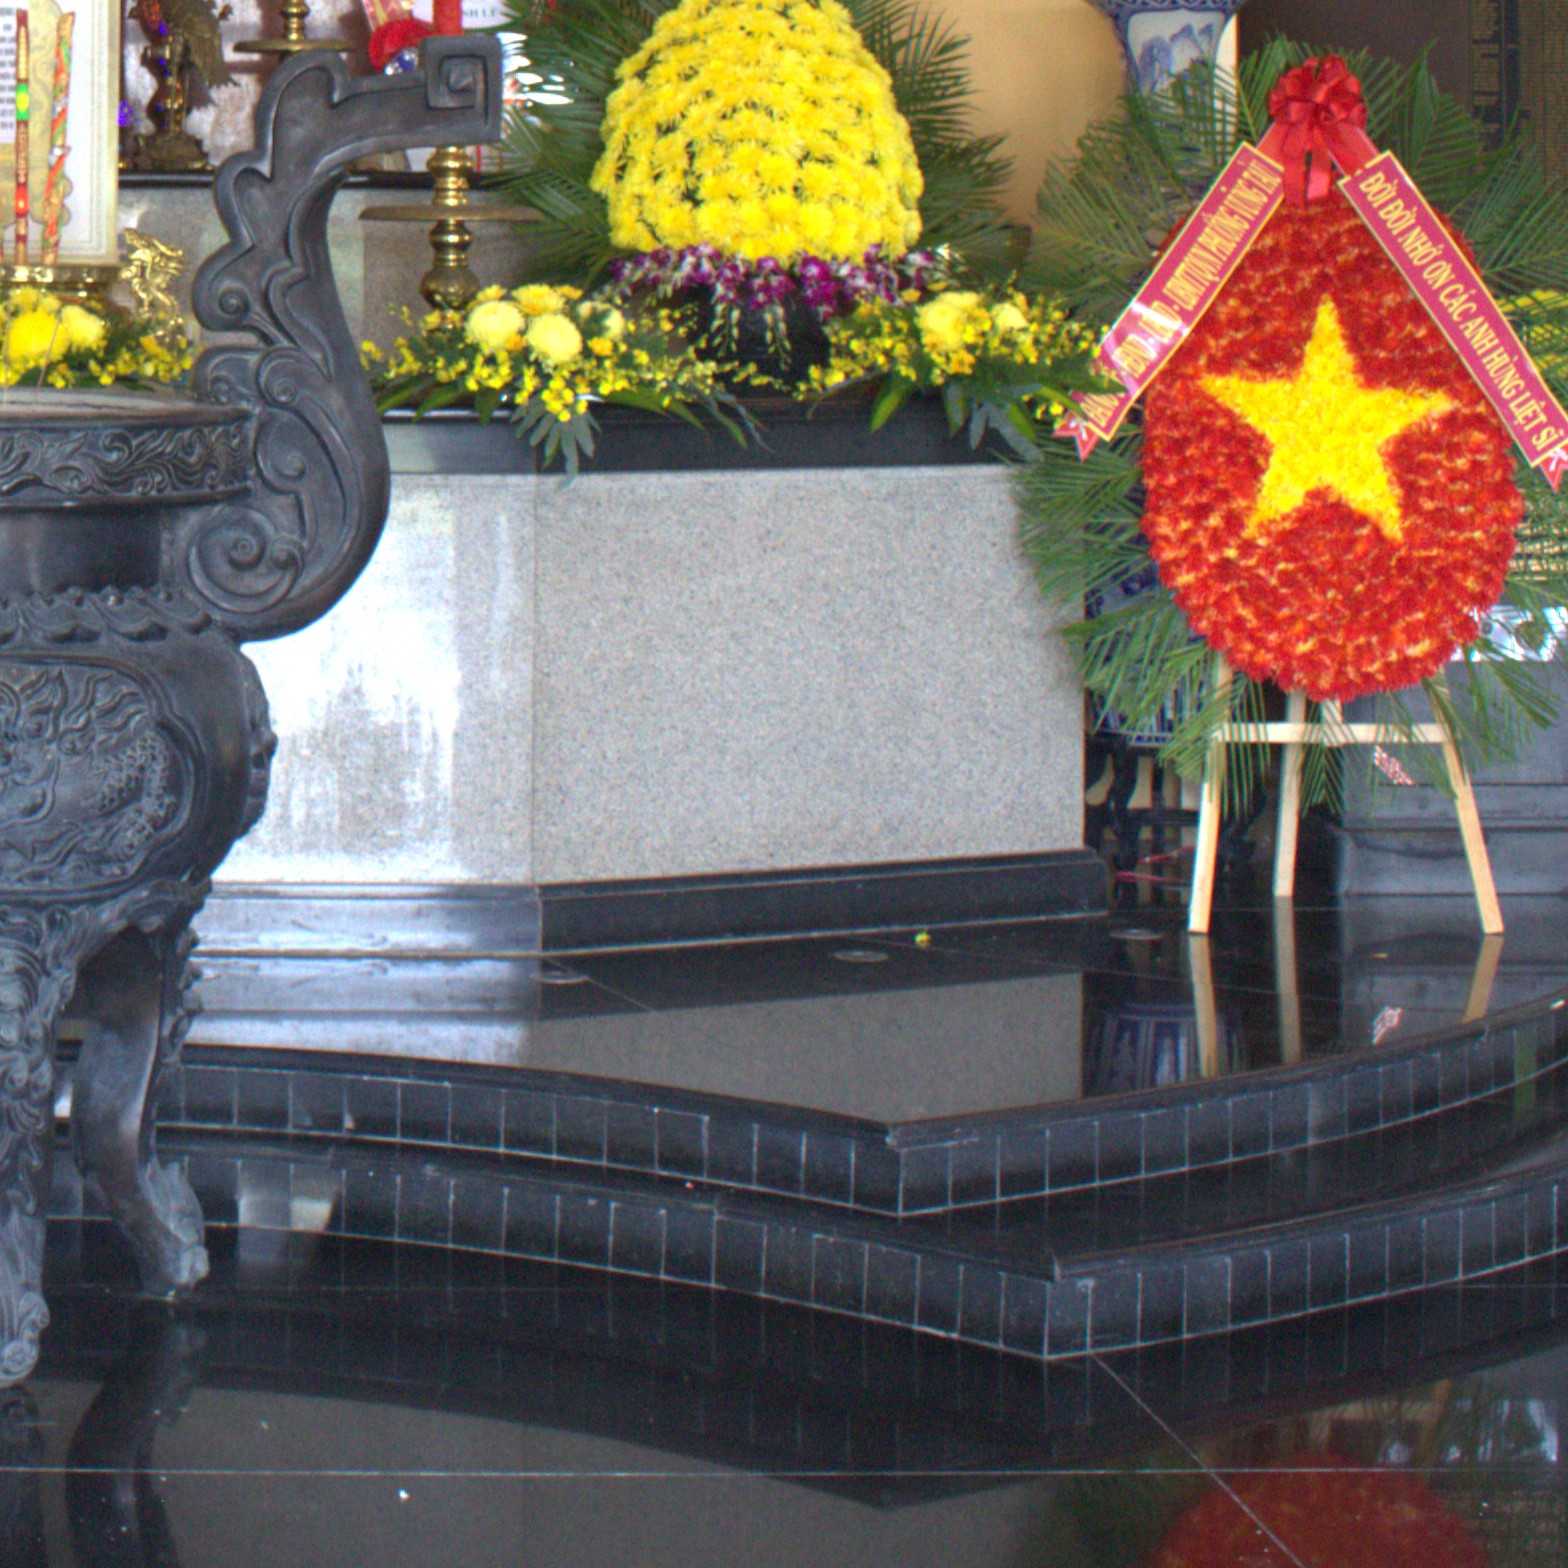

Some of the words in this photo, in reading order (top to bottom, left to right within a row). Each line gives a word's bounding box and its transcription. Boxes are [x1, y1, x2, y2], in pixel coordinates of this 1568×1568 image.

[1220, 178, 1268, 221] VŨNG
[1357, 170, 1398, 208] ĐỜI
[1376, 197, 1417, 236] ĐỜI
[1395, 225, 1442, 269] NHỚ
[1418, 256, 1458, 290] ƠN
[1435, 281, 1480, 323] CÁC
[1457, 313, 1501, 356] ANH
[1477, 346, 1530, 400] HÙNG
[1506, 391, 1549, 433] LIỆT
